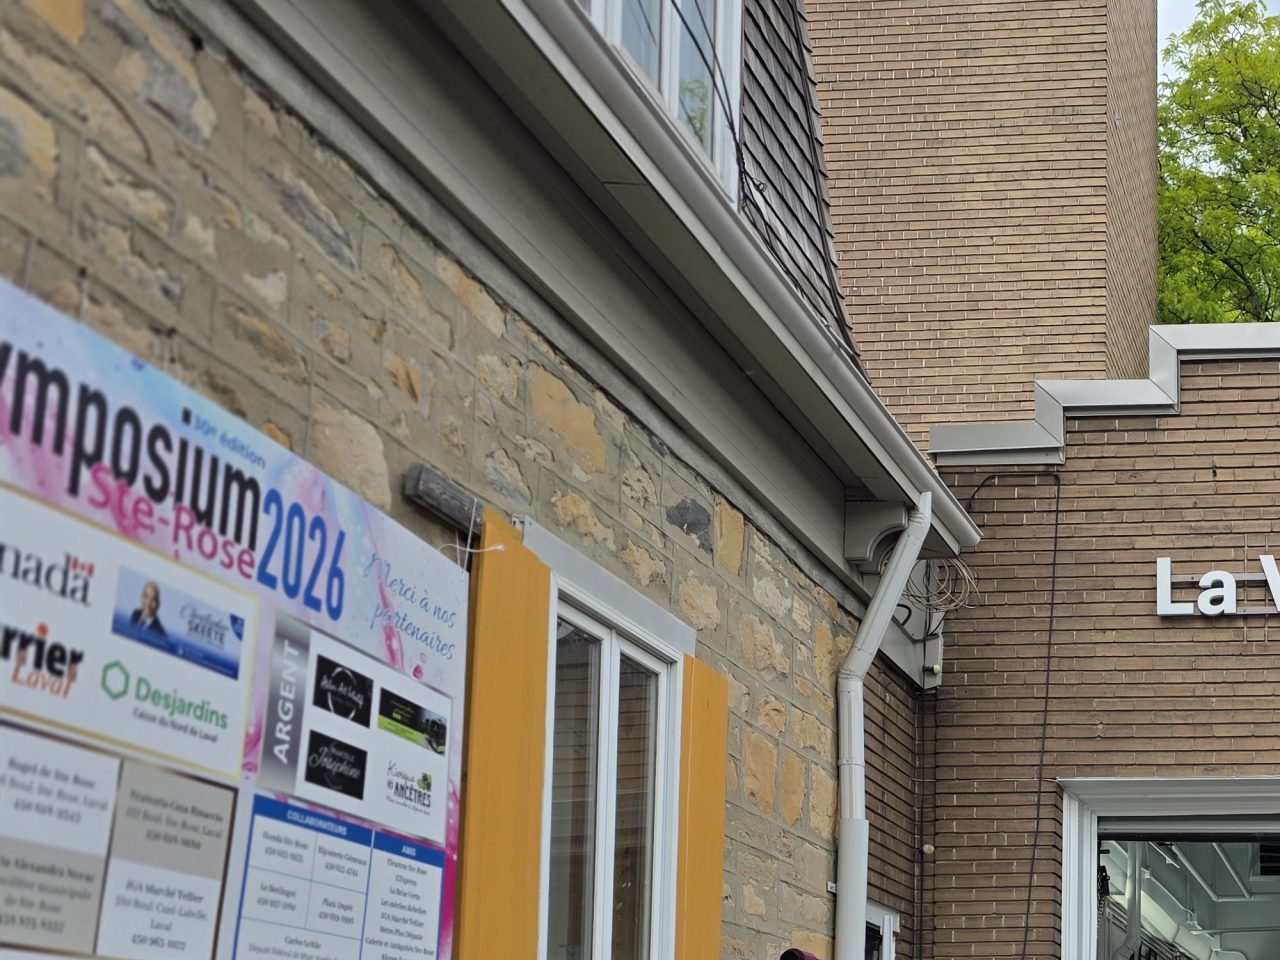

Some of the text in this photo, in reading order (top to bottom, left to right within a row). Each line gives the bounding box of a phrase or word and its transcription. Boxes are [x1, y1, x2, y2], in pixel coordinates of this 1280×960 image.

[219, 430, 266, 469] édition
[88, 463, 256, 580] Ste-Rose
[256, 488, 346, 622] 2026
[420, 588, 430, 612] à
[433, 604, 457, 628] nos
[1156, 556, 1238, 617] La
[369, 603, 455, 660] partenaires
[135, 676, 229, 730] Desjardins
[272, 640, 300, 765] ARGENT
[286, 809, 348, 836] COLLABORATEURS
